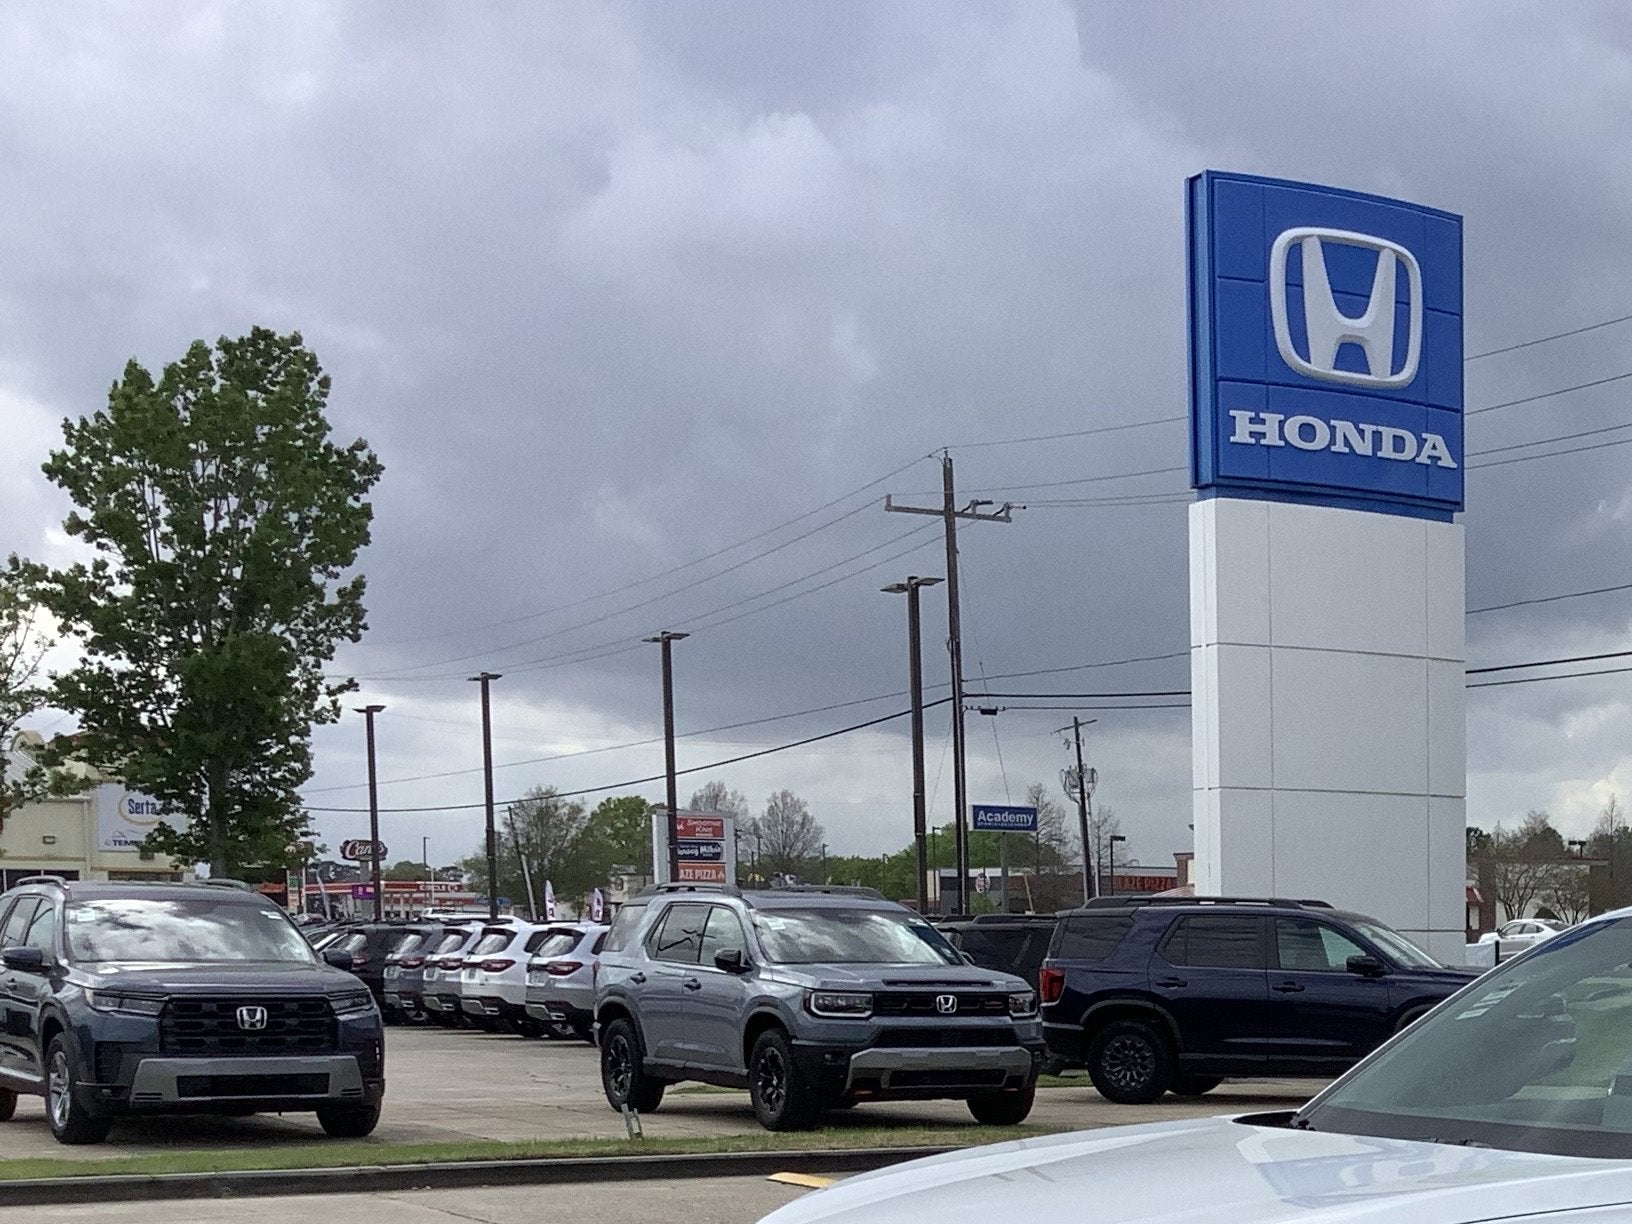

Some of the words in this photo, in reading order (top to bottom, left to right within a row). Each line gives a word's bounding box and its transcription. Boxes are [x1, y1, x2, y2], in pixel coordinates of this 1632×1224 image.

[1229, 409, 1458, 469] HONDA
[127, 798, 157, 815] Serta
[977, 810, 1034, 826] Academy
[695, 868, 717, 880] PIZZA
